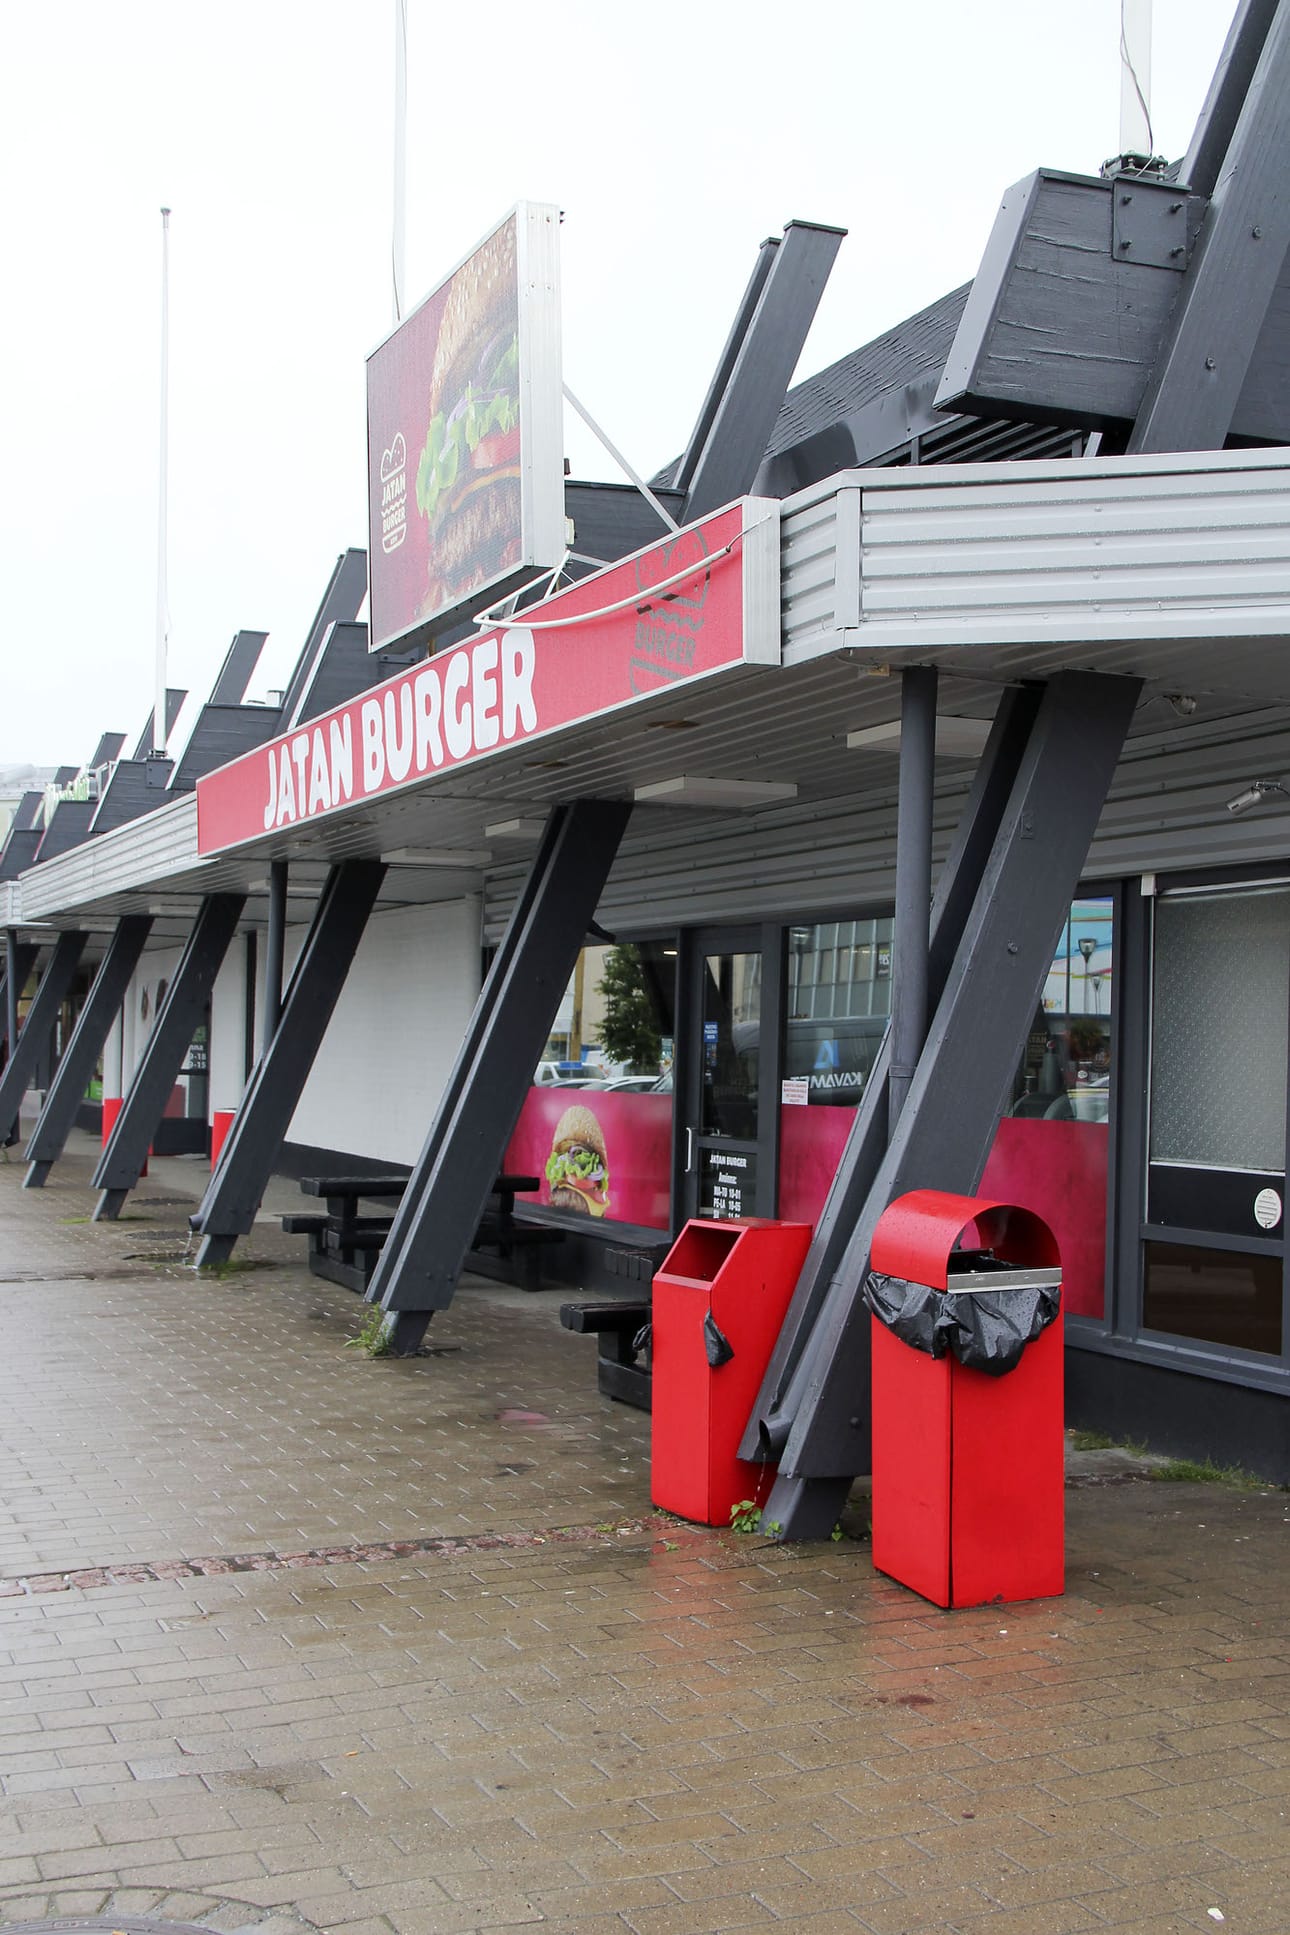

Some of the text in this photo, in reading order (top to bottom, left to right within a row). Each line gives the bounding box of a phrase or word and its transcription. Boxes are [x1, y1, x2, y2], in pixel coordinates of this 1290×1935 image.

[382, 472, 406, 506] JATAN
[383, 506, 406, 534] BURGER
[634, 621, 696, 668] BURGER
[264, 629, 538, 830] JATAN BURGER
[710, 1154, 747, 1168] JATAN BURGER
